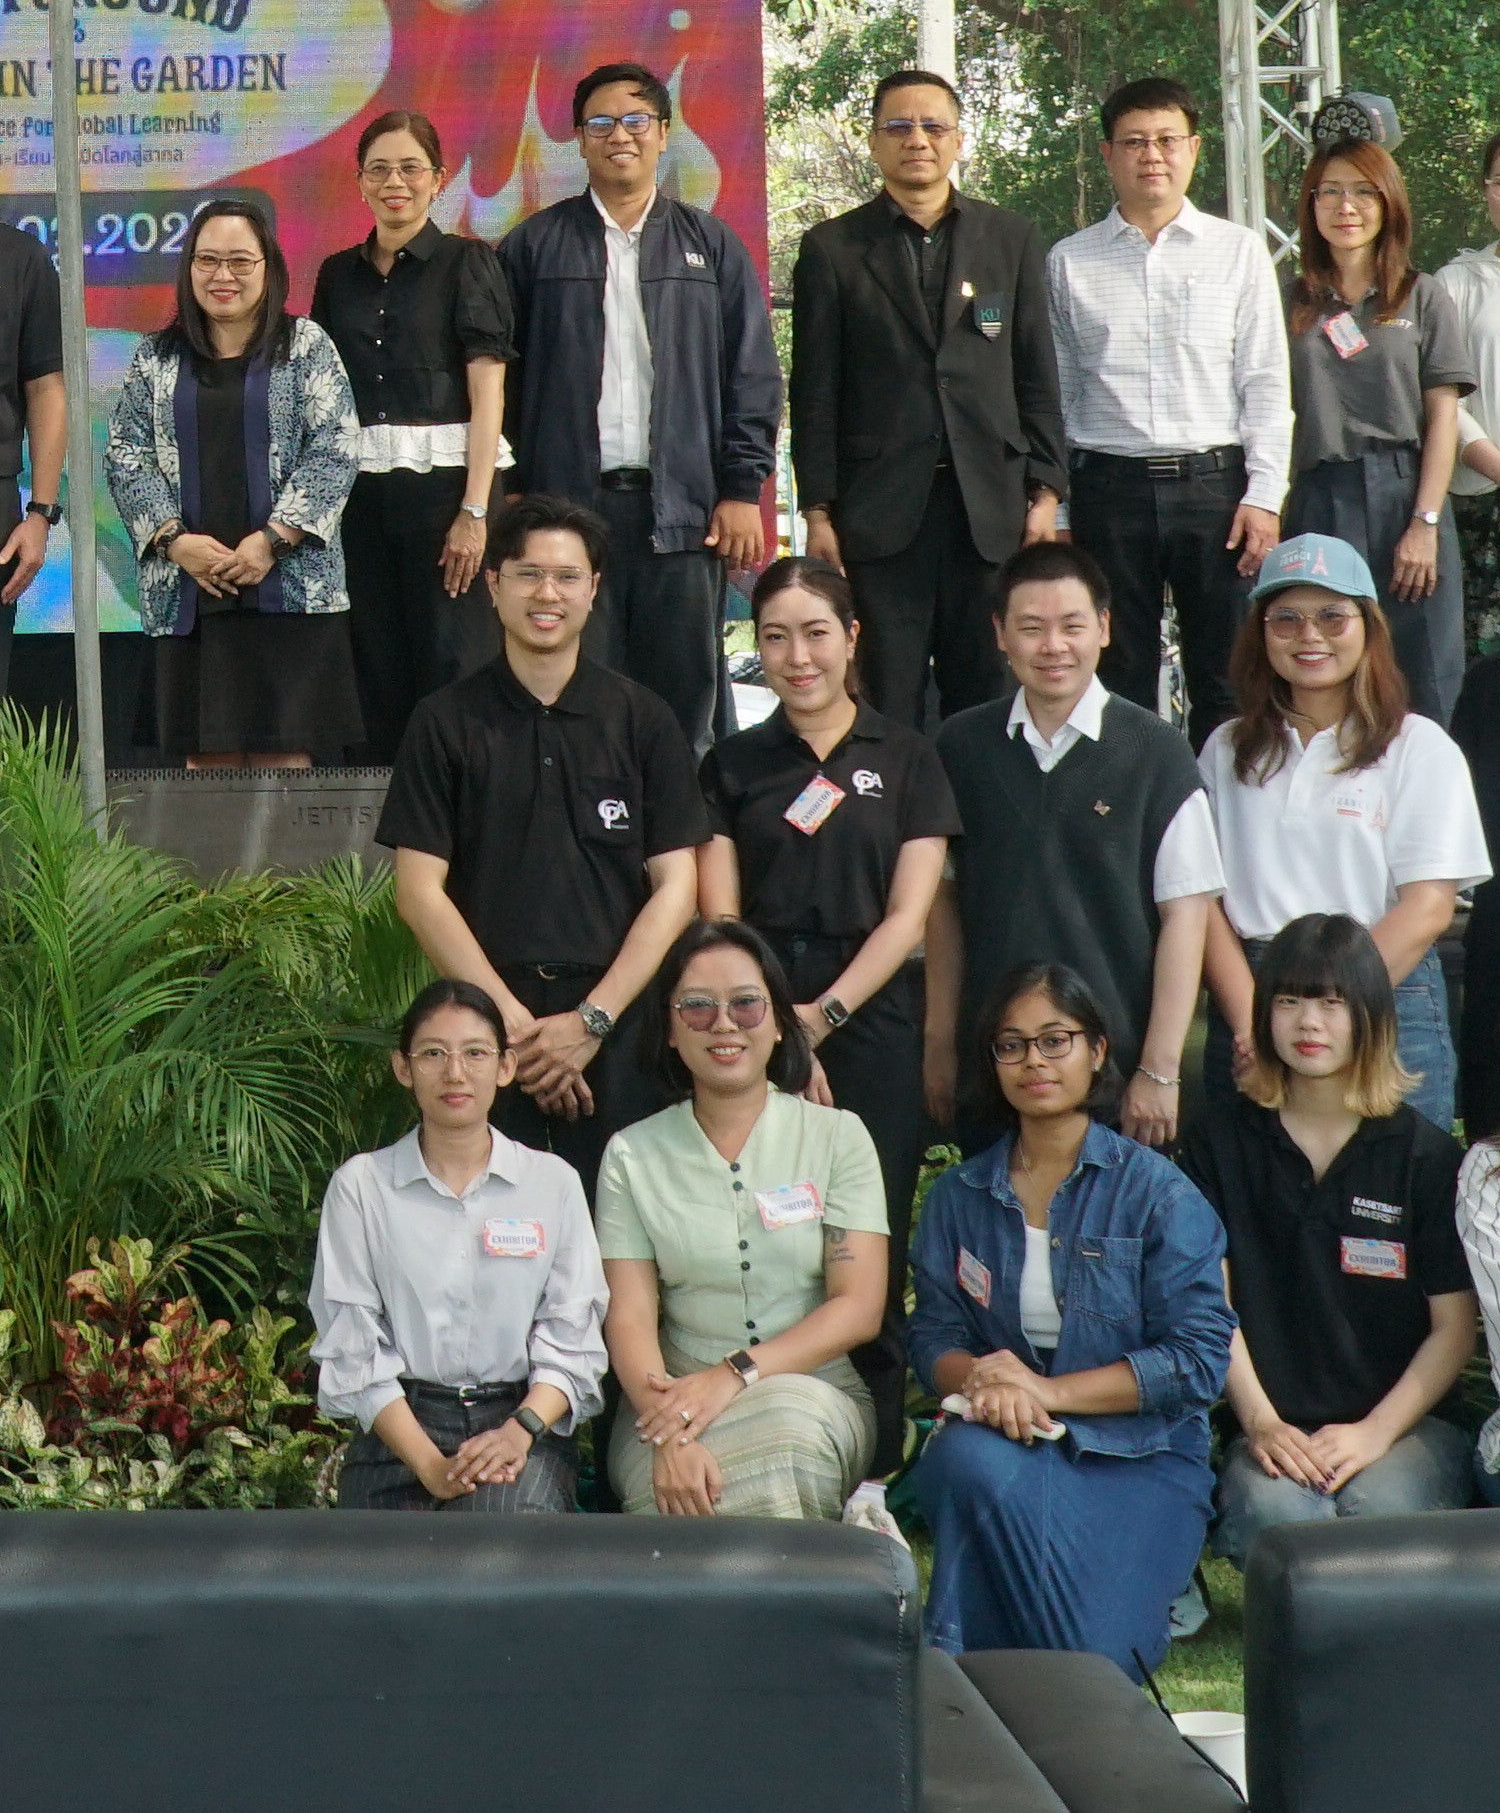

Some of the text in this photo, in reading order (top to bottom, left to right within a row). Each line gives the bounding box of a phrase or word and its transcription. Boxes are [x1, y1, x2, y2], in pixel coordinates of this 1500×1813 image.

[131, 53, 287, 93] GARDEN
[128, 110, 221, 137] Learning
[1353, 1196, 1403, 1214] KASETSART
[1351, 1207, 1402, 1224] UNIVERSITY
[491, 1234, 538, 1246] EXHIBITOR
